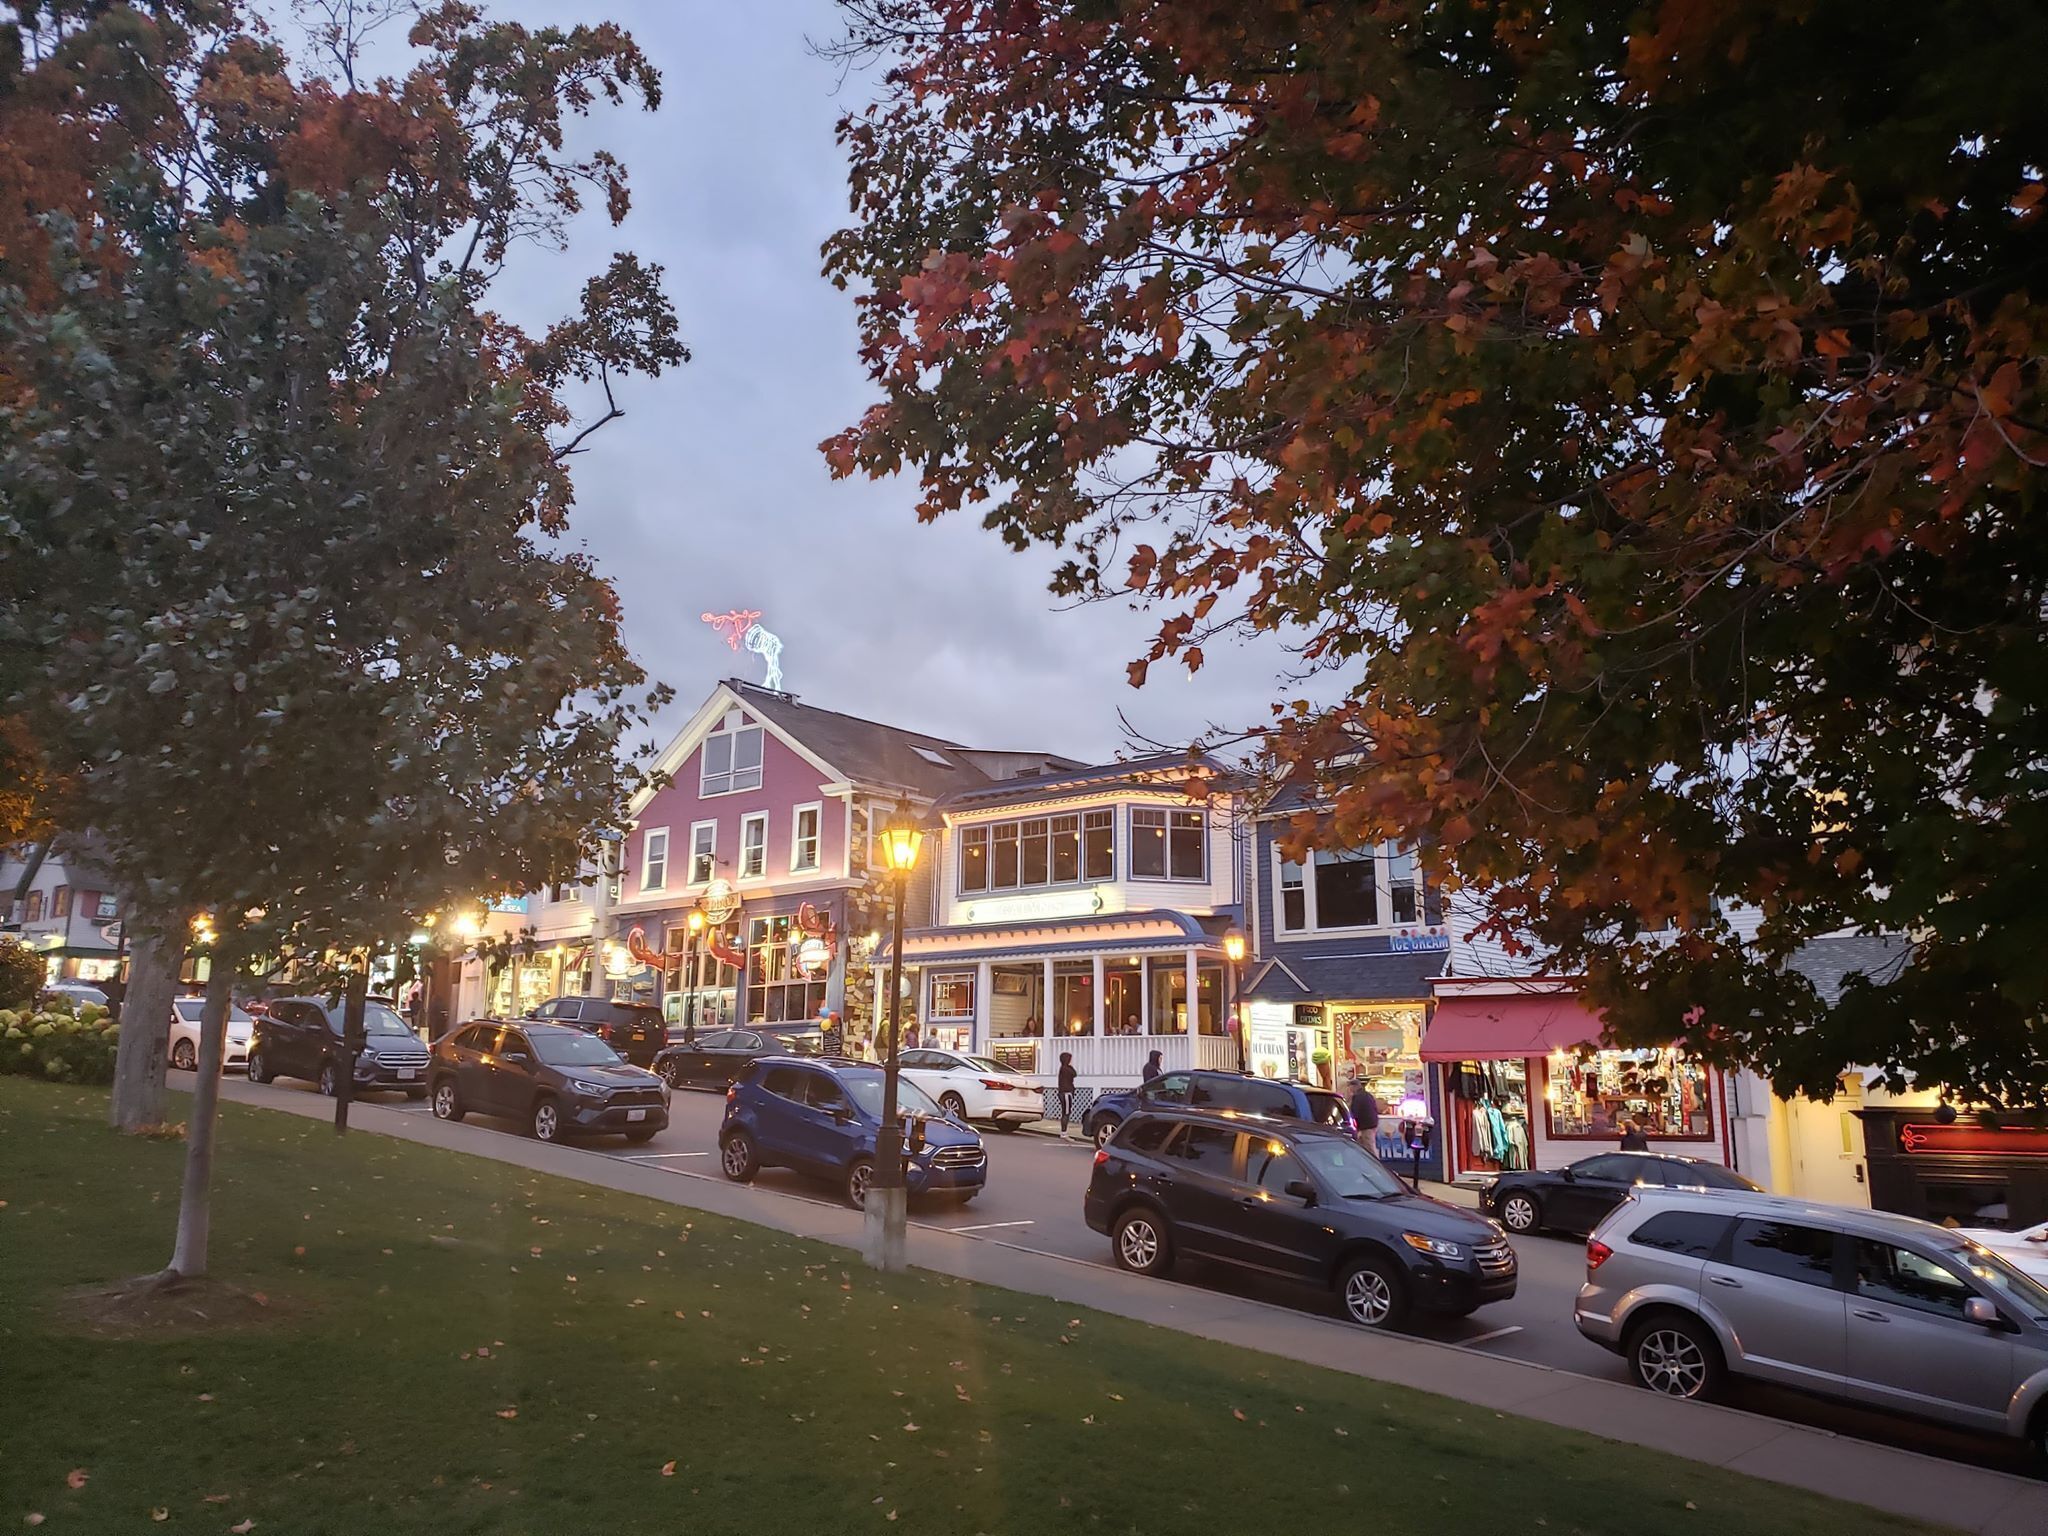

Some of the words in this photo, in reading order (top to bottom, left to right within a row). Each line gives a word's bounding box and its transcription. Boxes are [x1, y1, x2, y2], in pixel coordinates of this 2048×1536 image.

[1392, 937, 1409, 951] ICE
[1411, 934, 1449, 950] CREAM
[1263, 1042, 1285, 1056] CREAM
